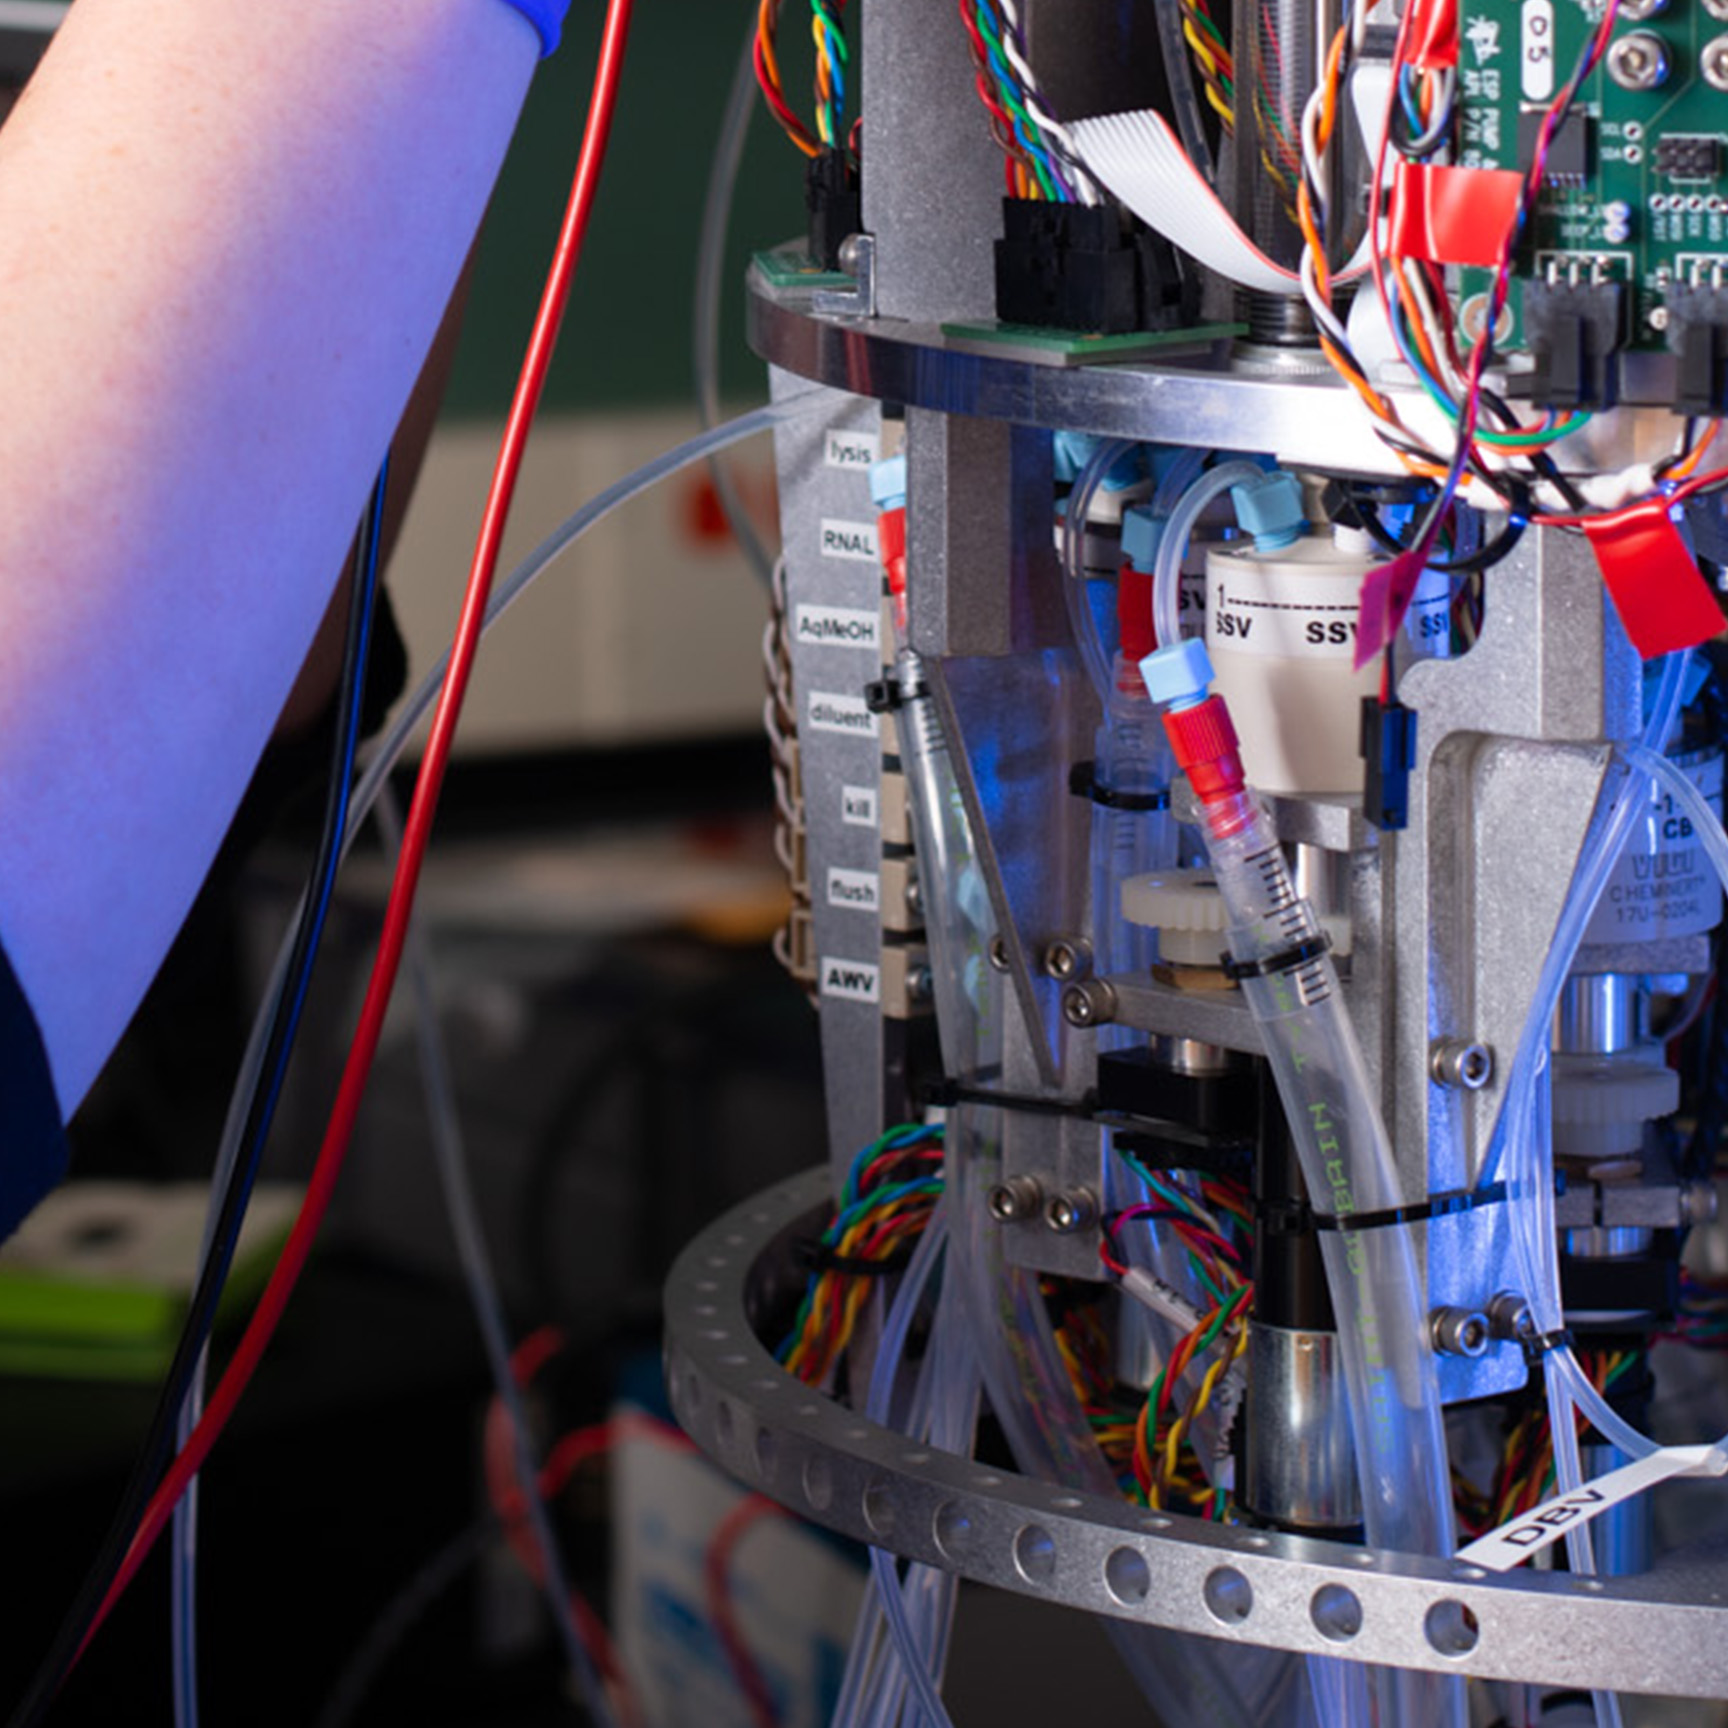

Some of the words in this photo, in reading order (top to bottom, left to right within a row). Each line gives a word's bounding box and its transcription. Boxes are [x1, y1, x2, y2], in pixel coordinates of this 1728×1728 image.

[1481, 69, 1500, 101] ESP
[1482, 108, 1500, 150] PUMP
[831, 440, 872, 464] lysis
[824, 530, 874, 555] RNAL
[800, 617, 874, 641] AqMeOH
[809, 702, 871, 728] diluent
[845, 797, 870, 819] kill
[830, 879, 874, 902] flush
[828, 967, 875, 992] AWV
[1501, 1489, 1605, 1546] DBV
